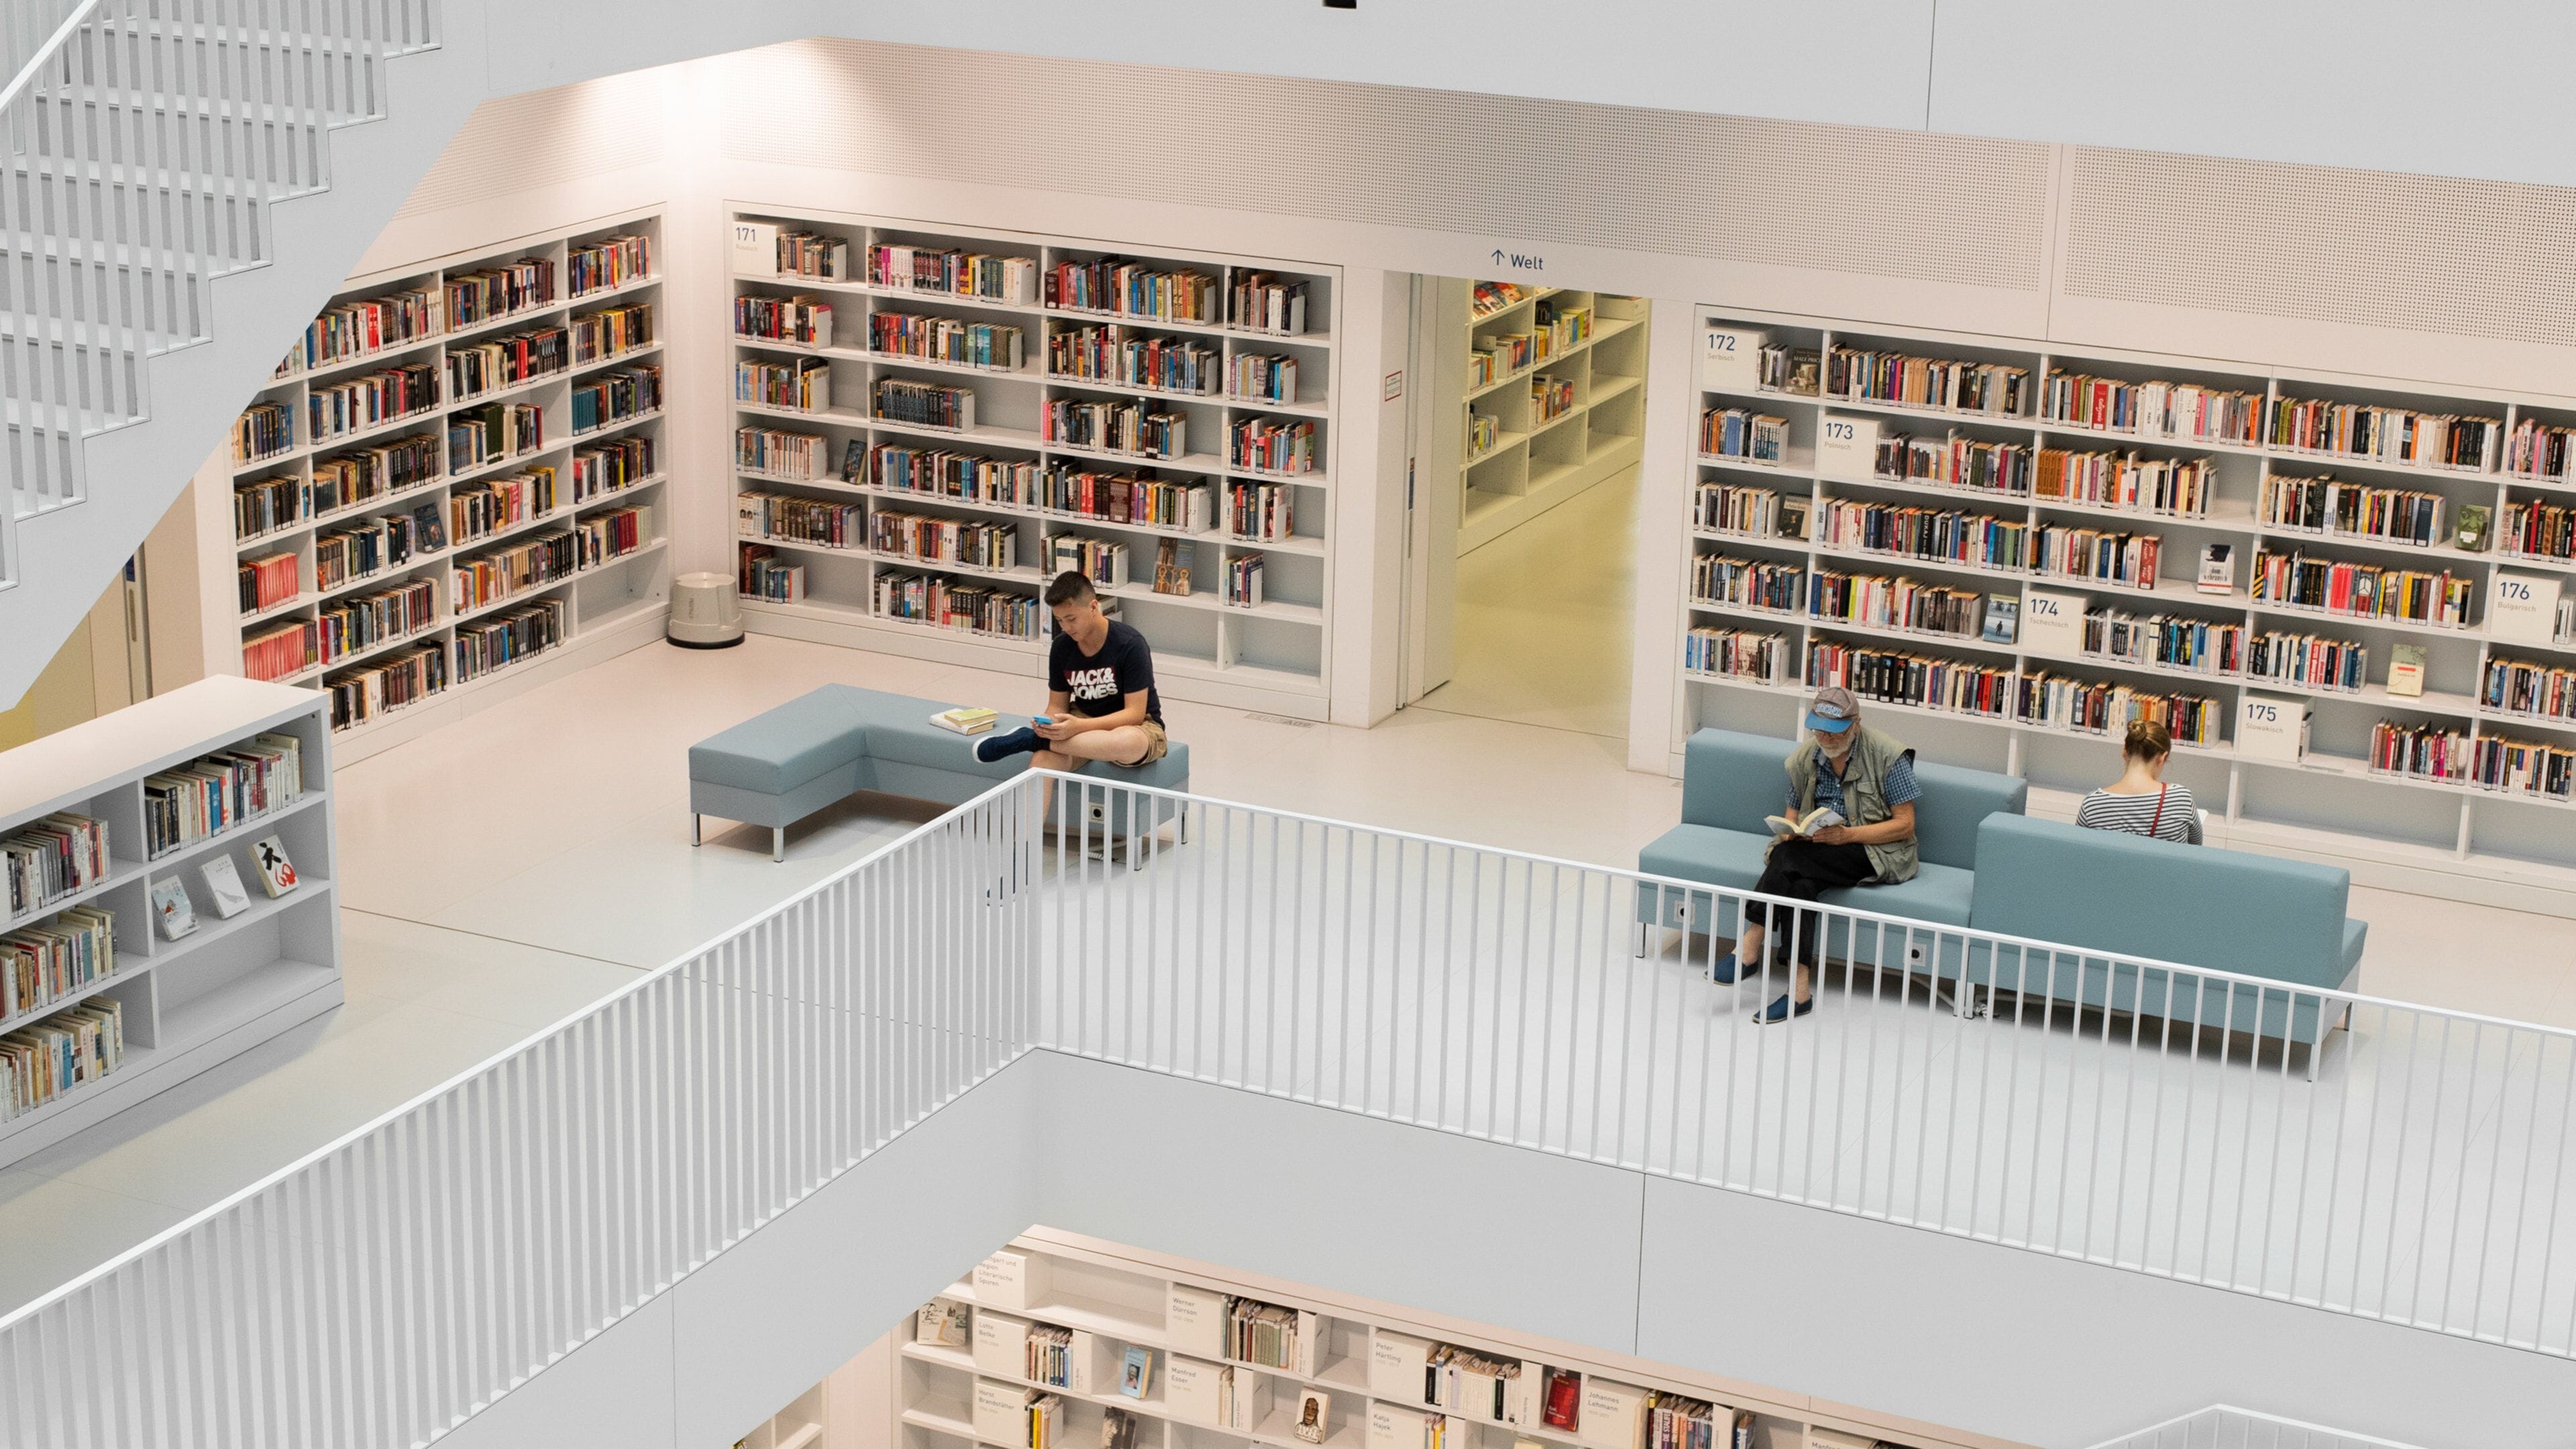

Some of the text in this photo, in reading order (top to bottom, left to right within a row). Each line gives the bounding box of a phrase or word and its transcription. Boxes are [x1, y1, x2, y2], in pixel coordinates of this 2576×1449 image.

[736, 227, 755, 242] 171
[1511, 254, 1543, 270] Welt
[1708, 333, 1735, 352] 172
[1707, 353, 1735, 362] Serbisch
[1826, 423, 1853, 440] 173
[1825, 441, 1851, 450] Polnisch
[2500, 582, 2530, 600] 176
[2031, 598, 2058, 616] 174
[2498, 601, 2536, 612] Bulgarisch
[2029, 617, 2069, 629] Tschechisch
[2247, 704, 2277, 722] 175
[2245, 722, 2284, 734] Slowakisch
[1173, 1297, 1195, 1307] Werner
[1376, 1342, 1393, 1350] Peter
[1171, 1367, 1197, 1377] Manfred
[1171, 1375, 1188, 1383] Esser
[1588, 1392, 1619, 1404] Johannes
[1588, 1400, 1619, 1411] Lehmann
[1374, 1413, 1390, 1423] Katja
